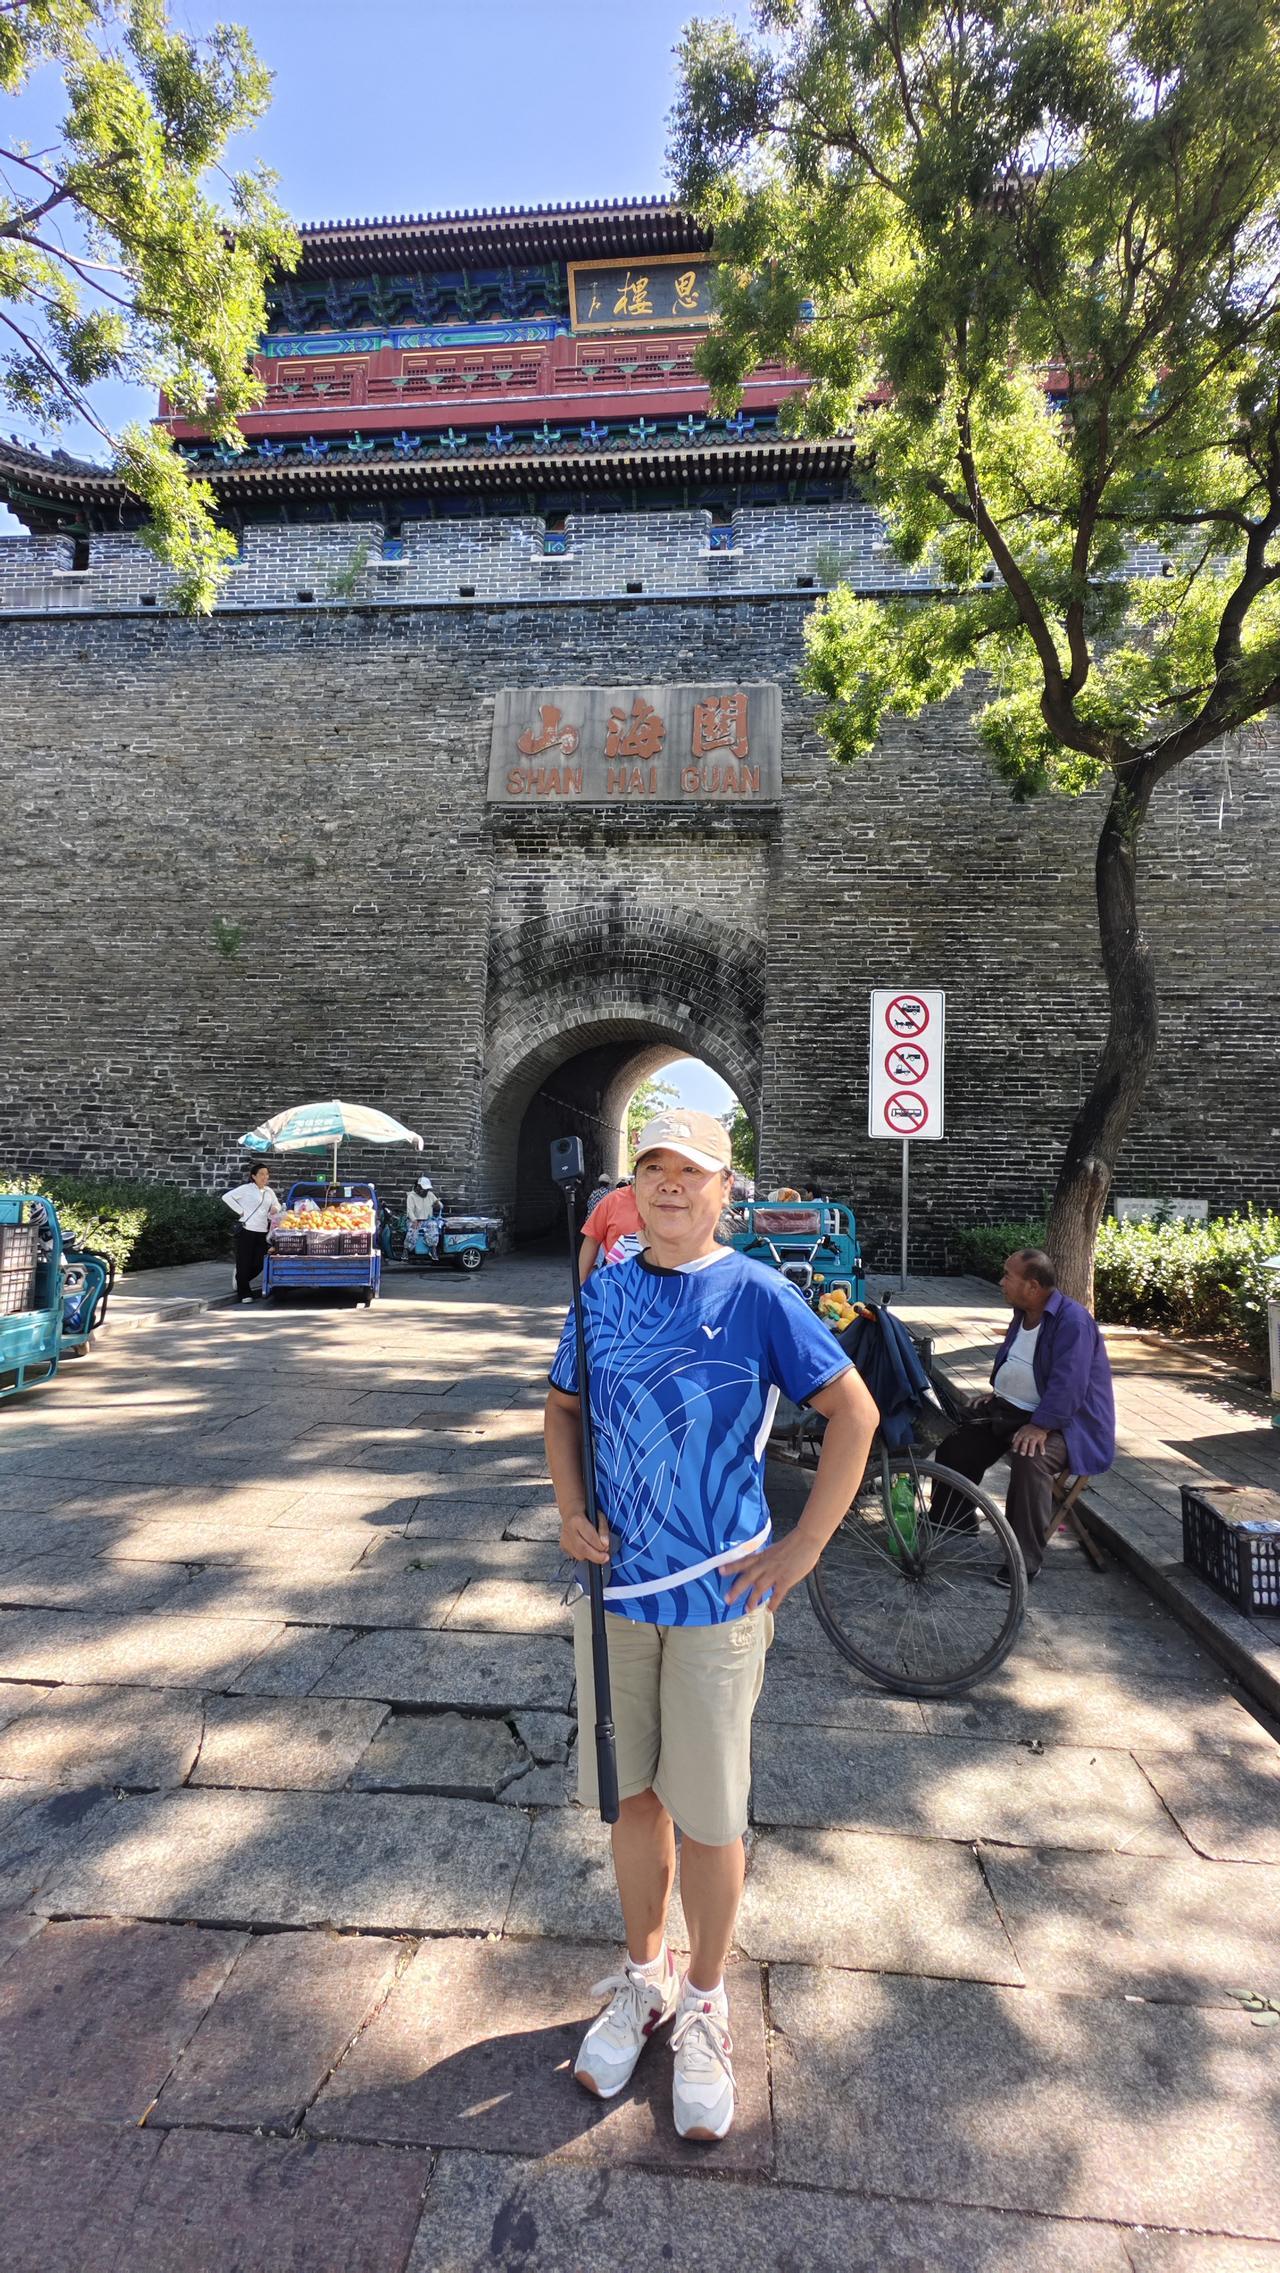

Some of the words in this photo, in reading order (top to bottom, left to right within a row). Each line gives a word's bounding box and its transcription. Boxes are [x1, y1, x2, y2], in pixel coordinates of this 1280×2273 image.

[506, 767, 584, 794] SHAN
[607, 766, 657, 794] HAI
[680, 765, 760, 793] GUAN
